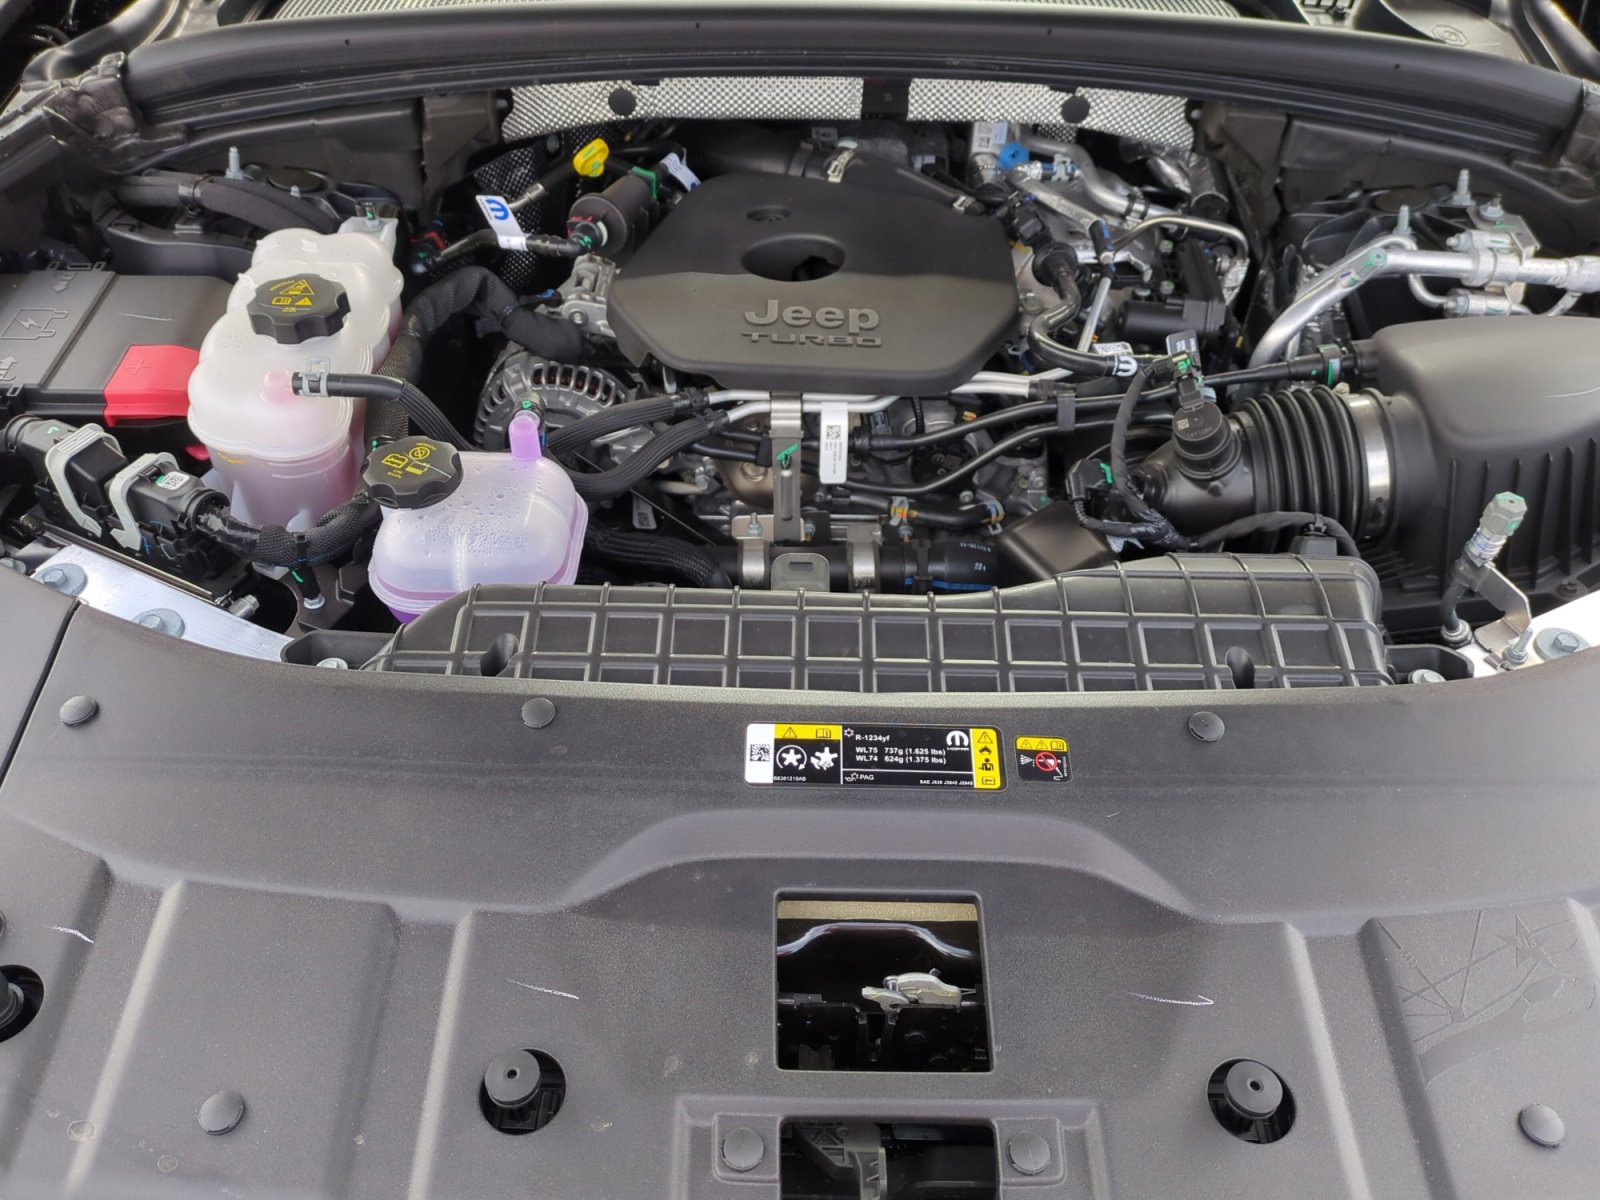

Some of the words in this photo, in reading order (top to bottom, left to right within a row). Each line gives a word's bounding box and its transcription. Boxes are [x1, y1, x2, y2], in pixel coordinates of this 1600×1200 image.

[744, 299, 880, 336] Jeep
[741, 332, 882, 349] TURBO
[856, 734, 890, 742] R-1234yf
[884, 747, 904, 756] 737g
[905, 747, 929, 756] (1.625
[930, 748, 946, 757] lbs)
[884, 756, 904, 764] 624g
[905, 756, 930, 765] (1.375
[931, 756, 947, 765] lbs)
